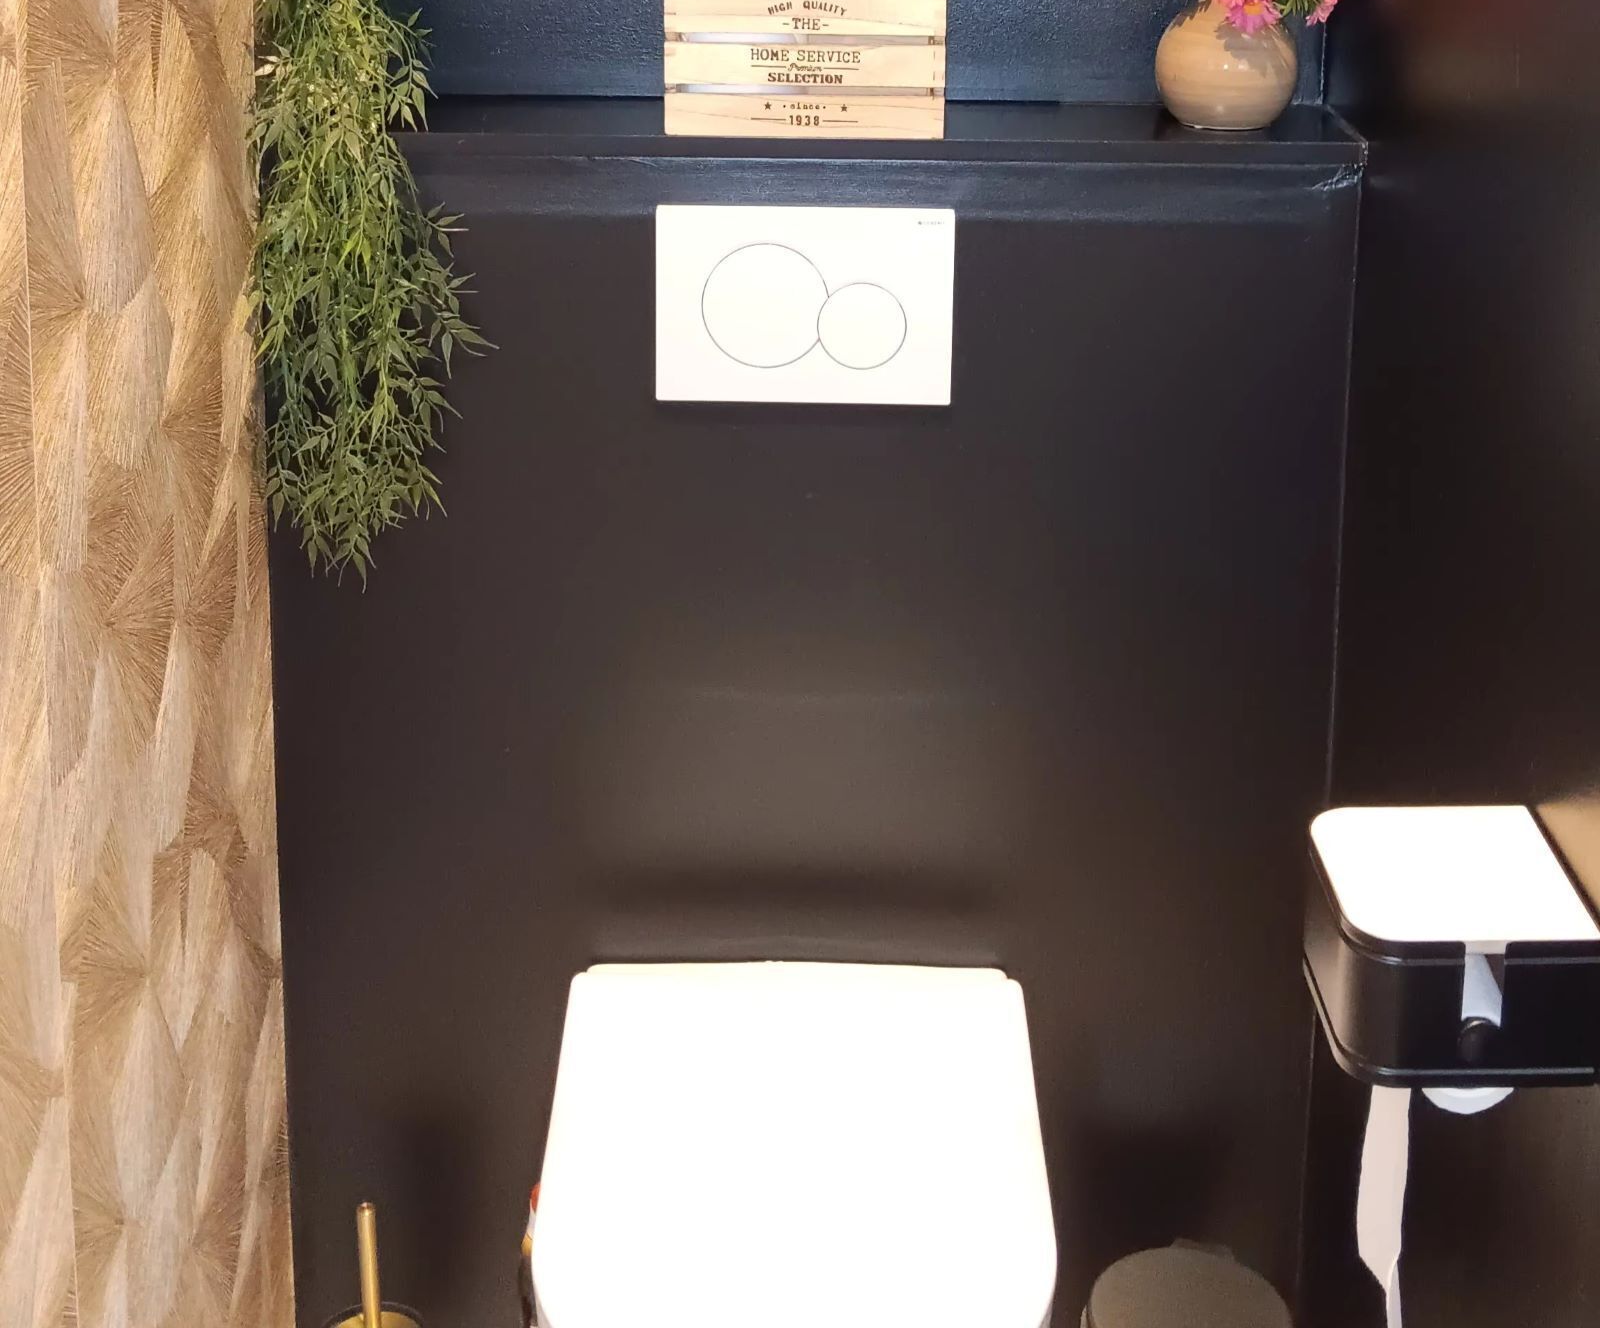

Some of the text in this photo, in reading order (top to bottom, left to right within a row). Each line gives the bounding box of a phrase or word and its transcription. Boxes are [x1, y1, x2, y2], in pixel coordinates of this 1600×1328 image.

[767, 0, 847, 16] HIGH QUALITY
[750, 48, 861, 64] HOME SERVICE
[767, 72, 843, 84] SELECTION
[789, 114, 820, 126] 1938
